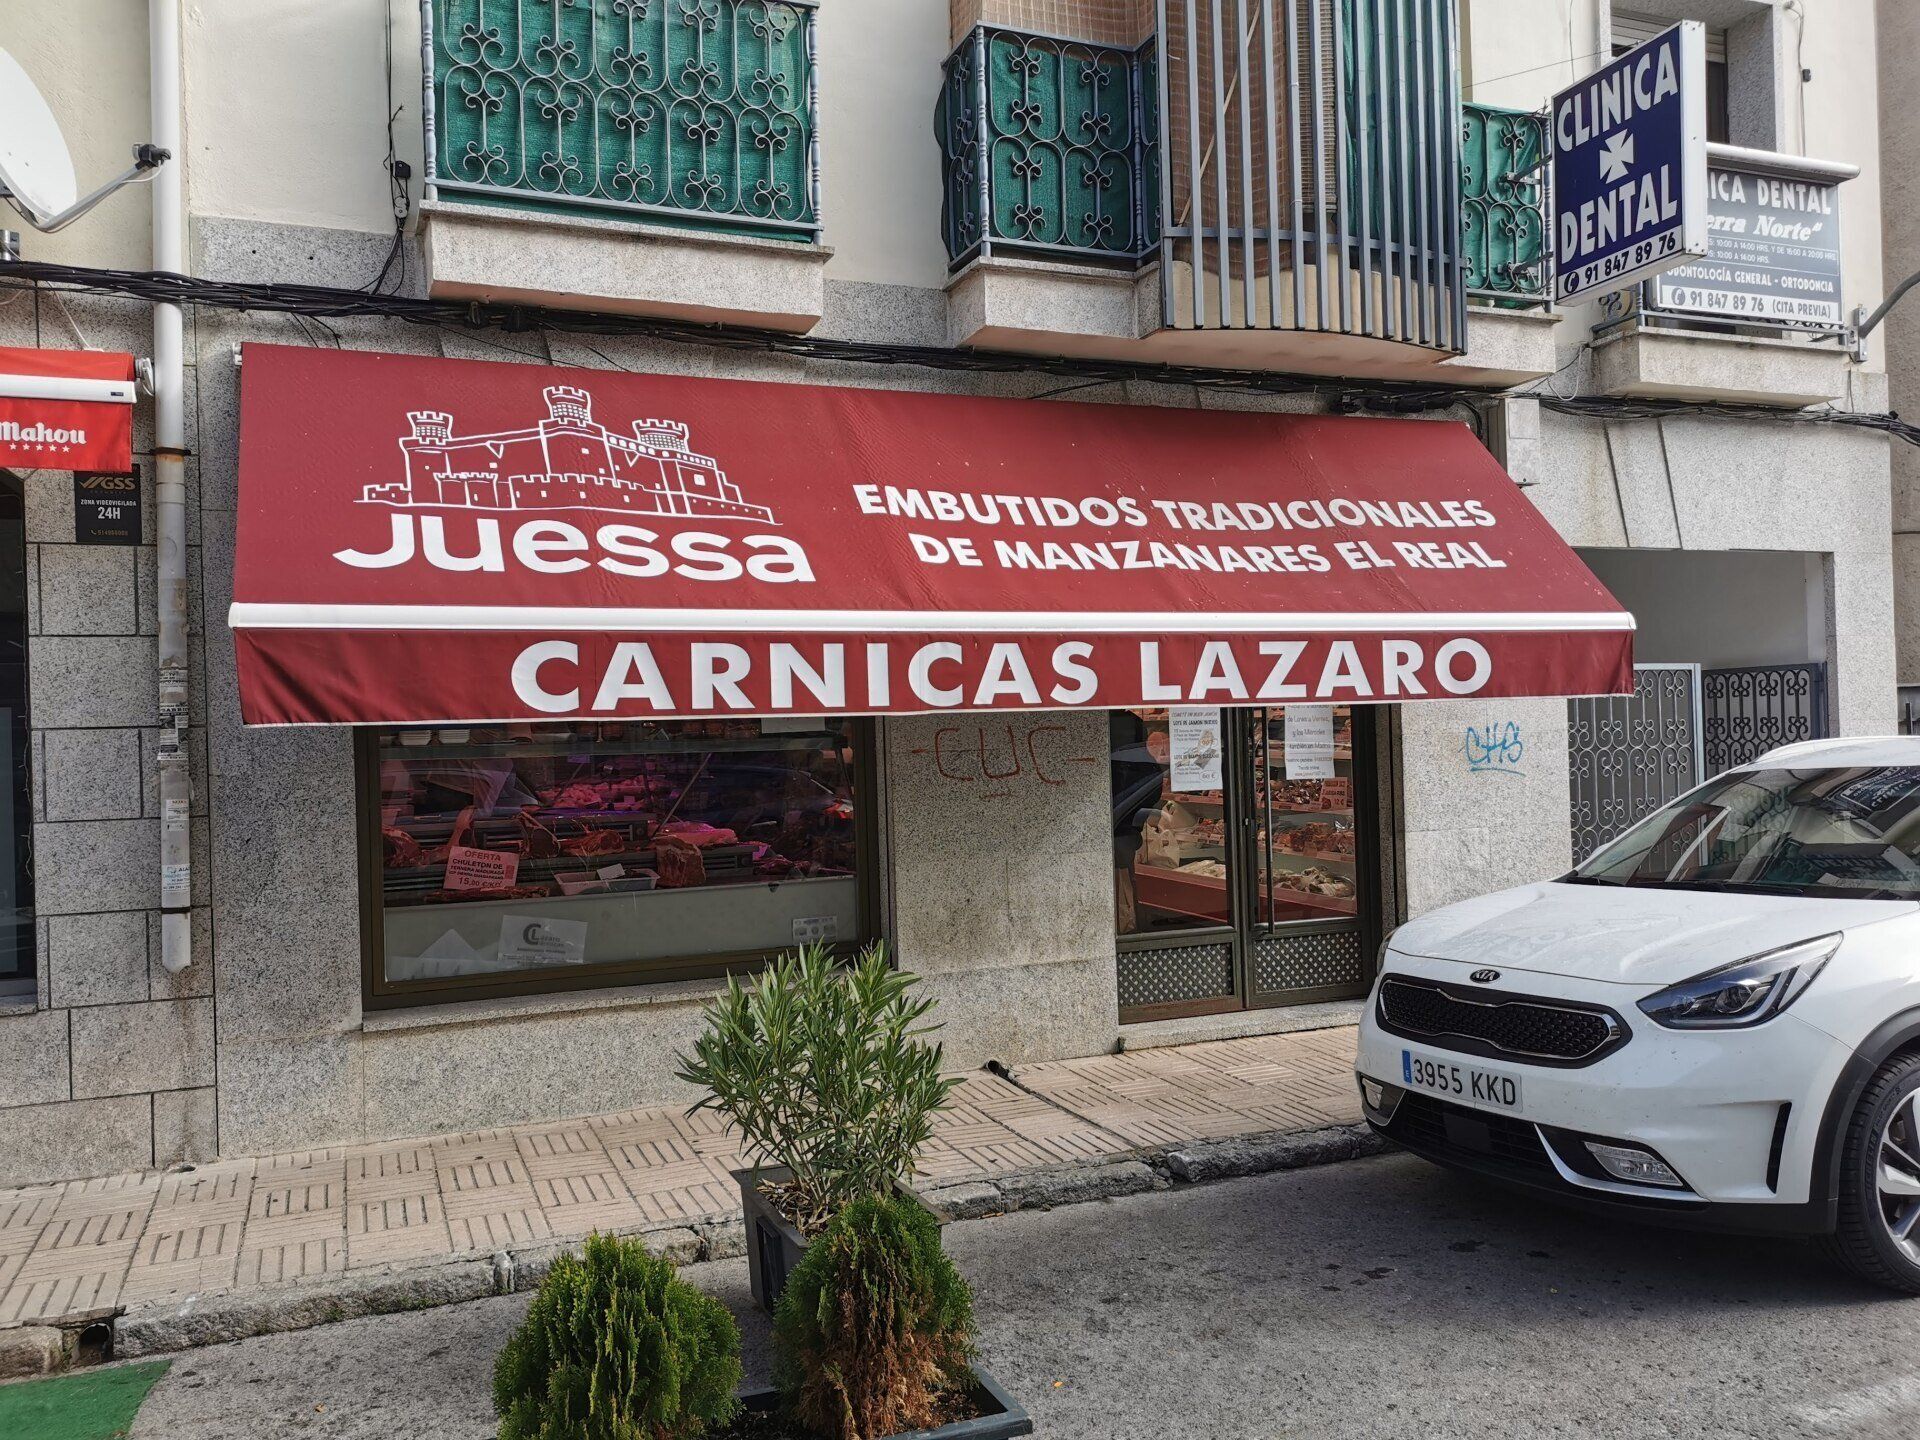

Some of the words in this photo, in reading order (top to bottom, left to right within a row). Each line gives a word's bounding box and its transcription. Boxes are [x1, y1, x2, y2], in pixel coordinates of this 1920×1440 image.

[1557, 42, 1678, 152] CLINICA
[1707, 172, 1746, 204] ICA
[1756, 179, 1832, 215] DENTAL
[1561, 164, 1678, 265] DENTAL
[1585, 264, 1598, 284] 91
[1604, 252, 1629, 276] 847
[1635, 242, 1652, 261] 89
[1658, 231, 1676, 252] 76
[1734, 240, 1738, 248] A
[1734, 252, 1739, 260] A
[1734, 271, 1772, 286] GENERAL
[1781, 276, 1834, 293] ORTODONCIA
[1690, 291, 1702, 306] 91
[1707, 293, 1728, 310] 847
[1733, 296, 1746, 311] 89
[1752, 296, 1764, 312] 76
[1772, 298, 1794, 314] (CITA
[1798, 302, 1831, 318] PREVIA)
[0, 421, 87, 444] Mahou
[100, 477, 136, 490] GSS
[98, 506, 120, 520] 24H
[852, 484, 1147, 528] EMBUTIDOS
[1150, 498, 1498, 532] TRADICIONALES
[333, 514, 816, 583] Juessa
[908, 534, 983, 567] DE
[994, 539, 1331, 573] MANZANARES
[1331, 541, 1396, 570] EL
[1394, 541, 1506, 570] REAL
[511, 638, 1099, 714] CARNICAS
[1139, 637, 1493, 700] LAZARO
[452, 858, 492, 868] CHULETON
[464, 850, 501, 861] OFERTA
[1472, 970, 1496, 980] KIA
[1414, 1059, 1463, 1094] 3955
[1471, 1070, 1516, 1106] KKD
